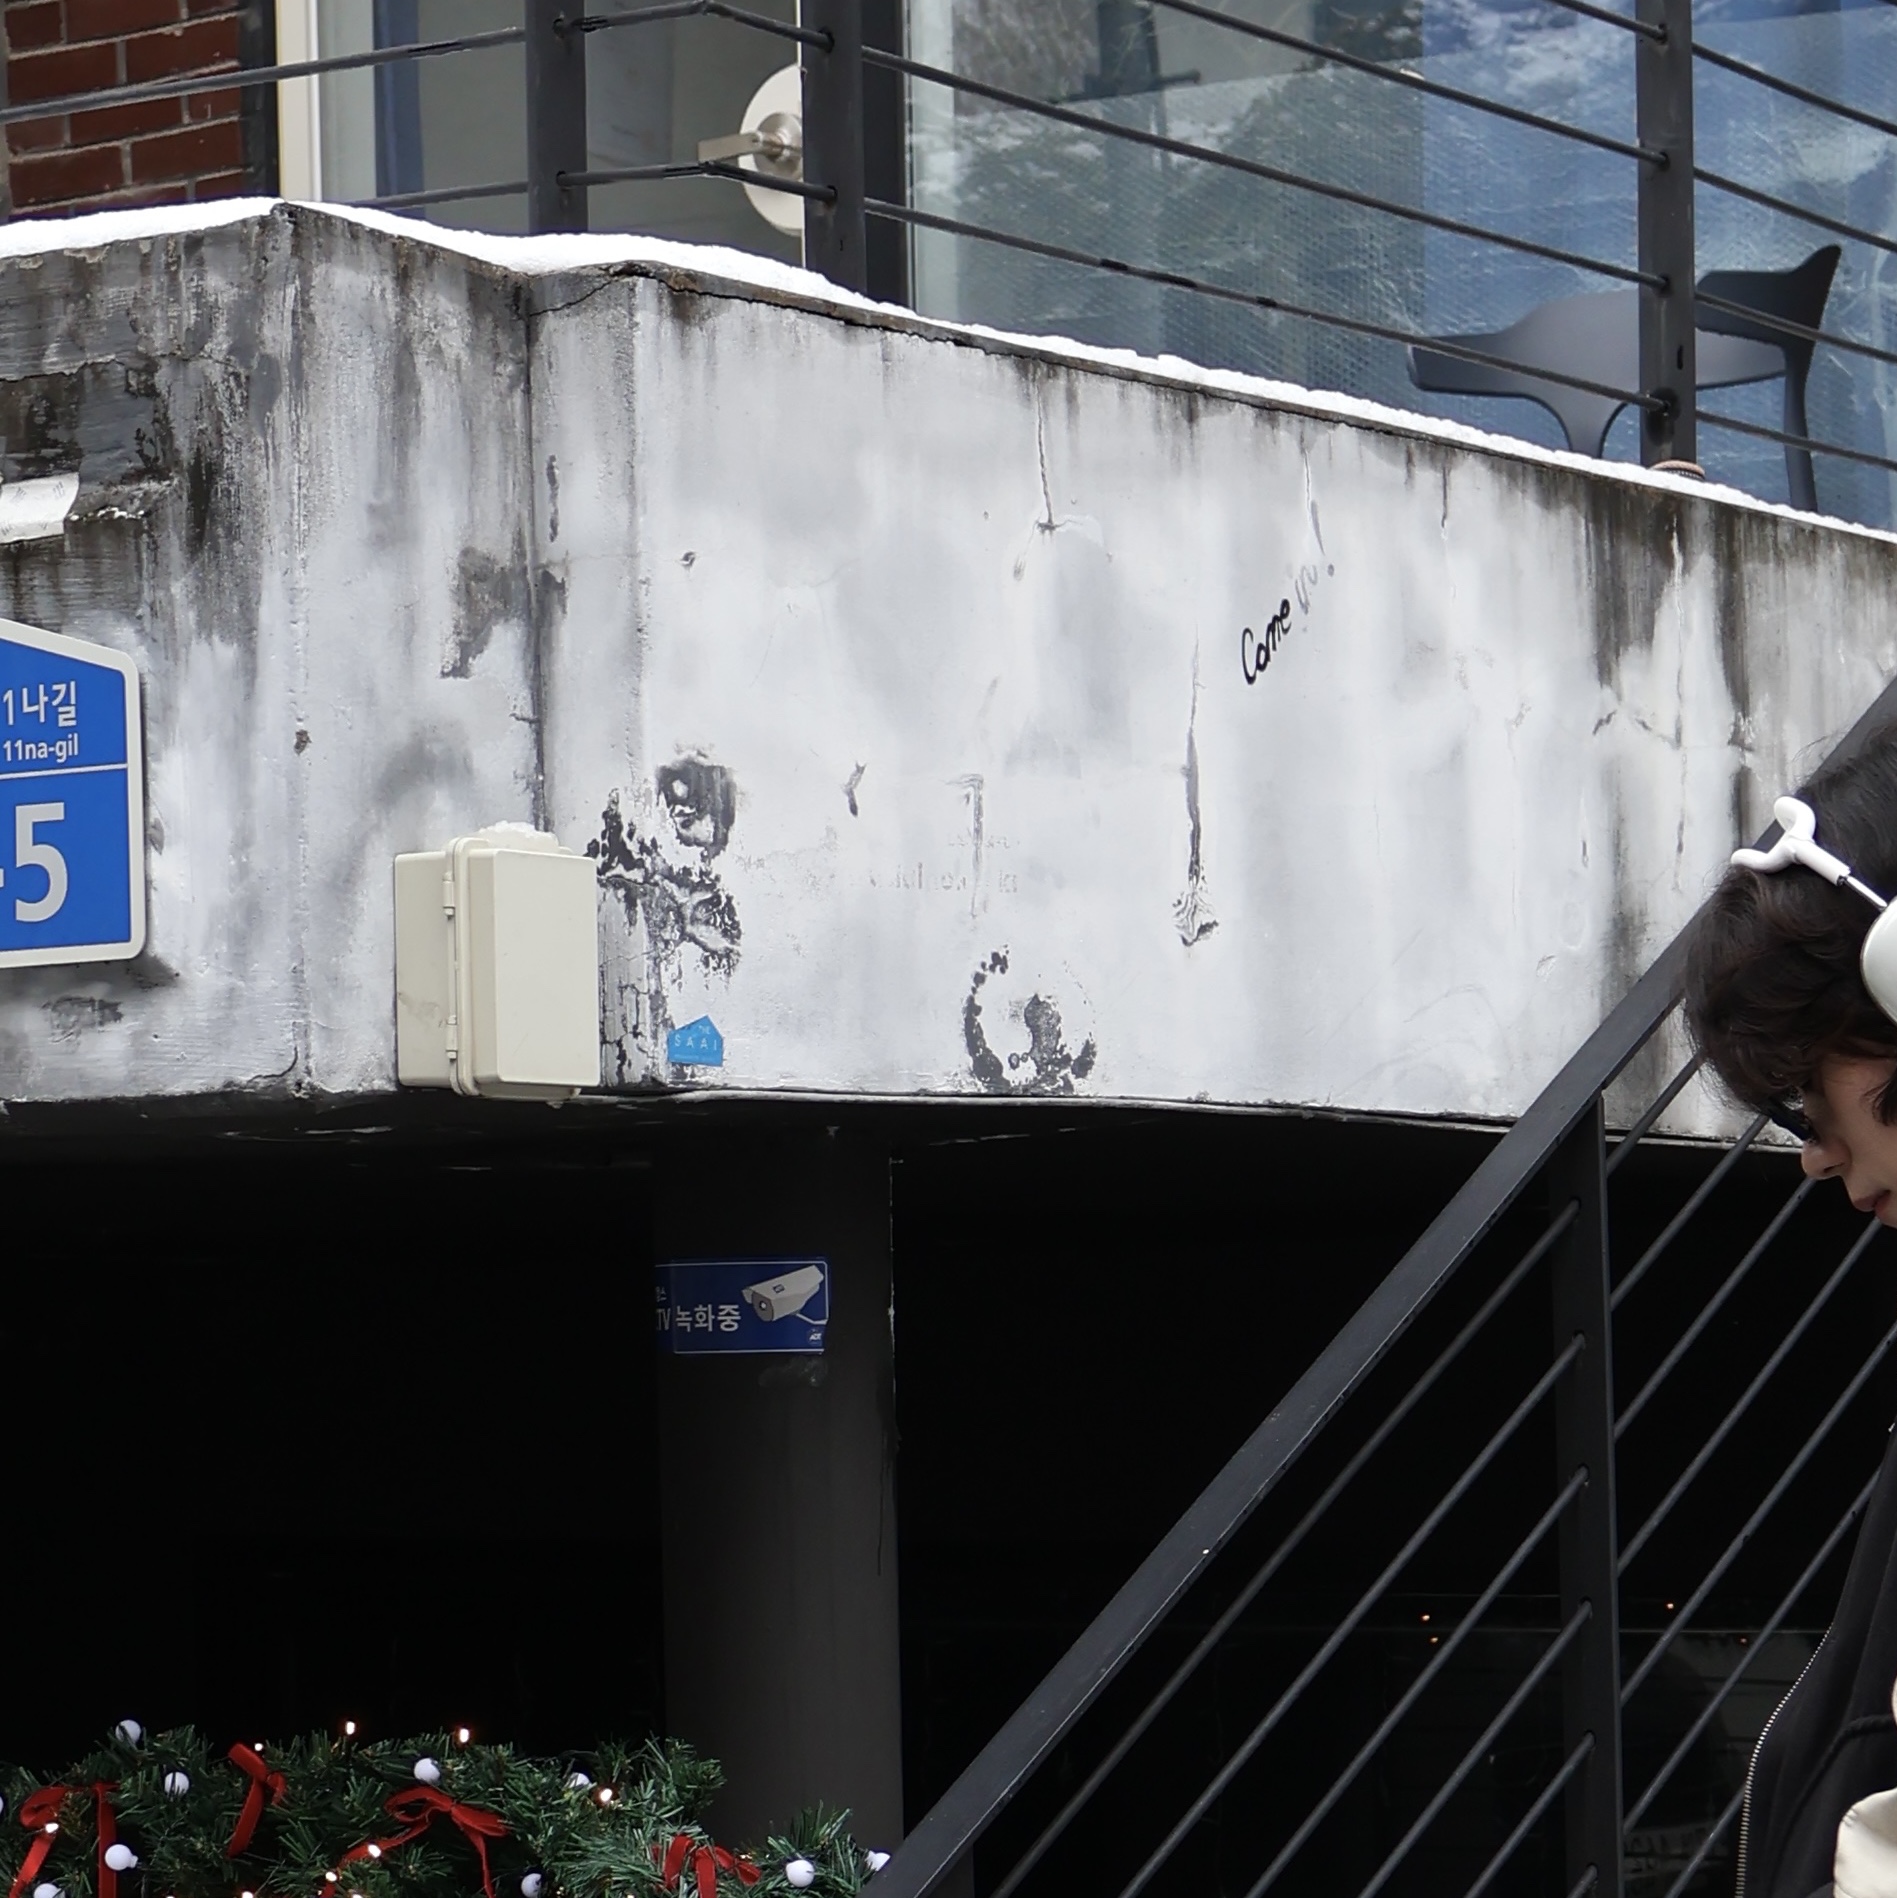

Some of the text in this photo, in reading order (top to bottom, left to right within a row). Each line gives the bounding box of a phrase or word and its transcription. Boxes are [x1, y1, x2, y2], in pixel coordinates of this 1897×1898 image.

[1241, 598, 1292, 685] Come
[2, 733, 79, 763] 11na-gil
[0, 801, 68, 923] 5
[674, 1033, 718, 1051] SAAI
[656, 1303, 742, 1333] TV 녹화중
